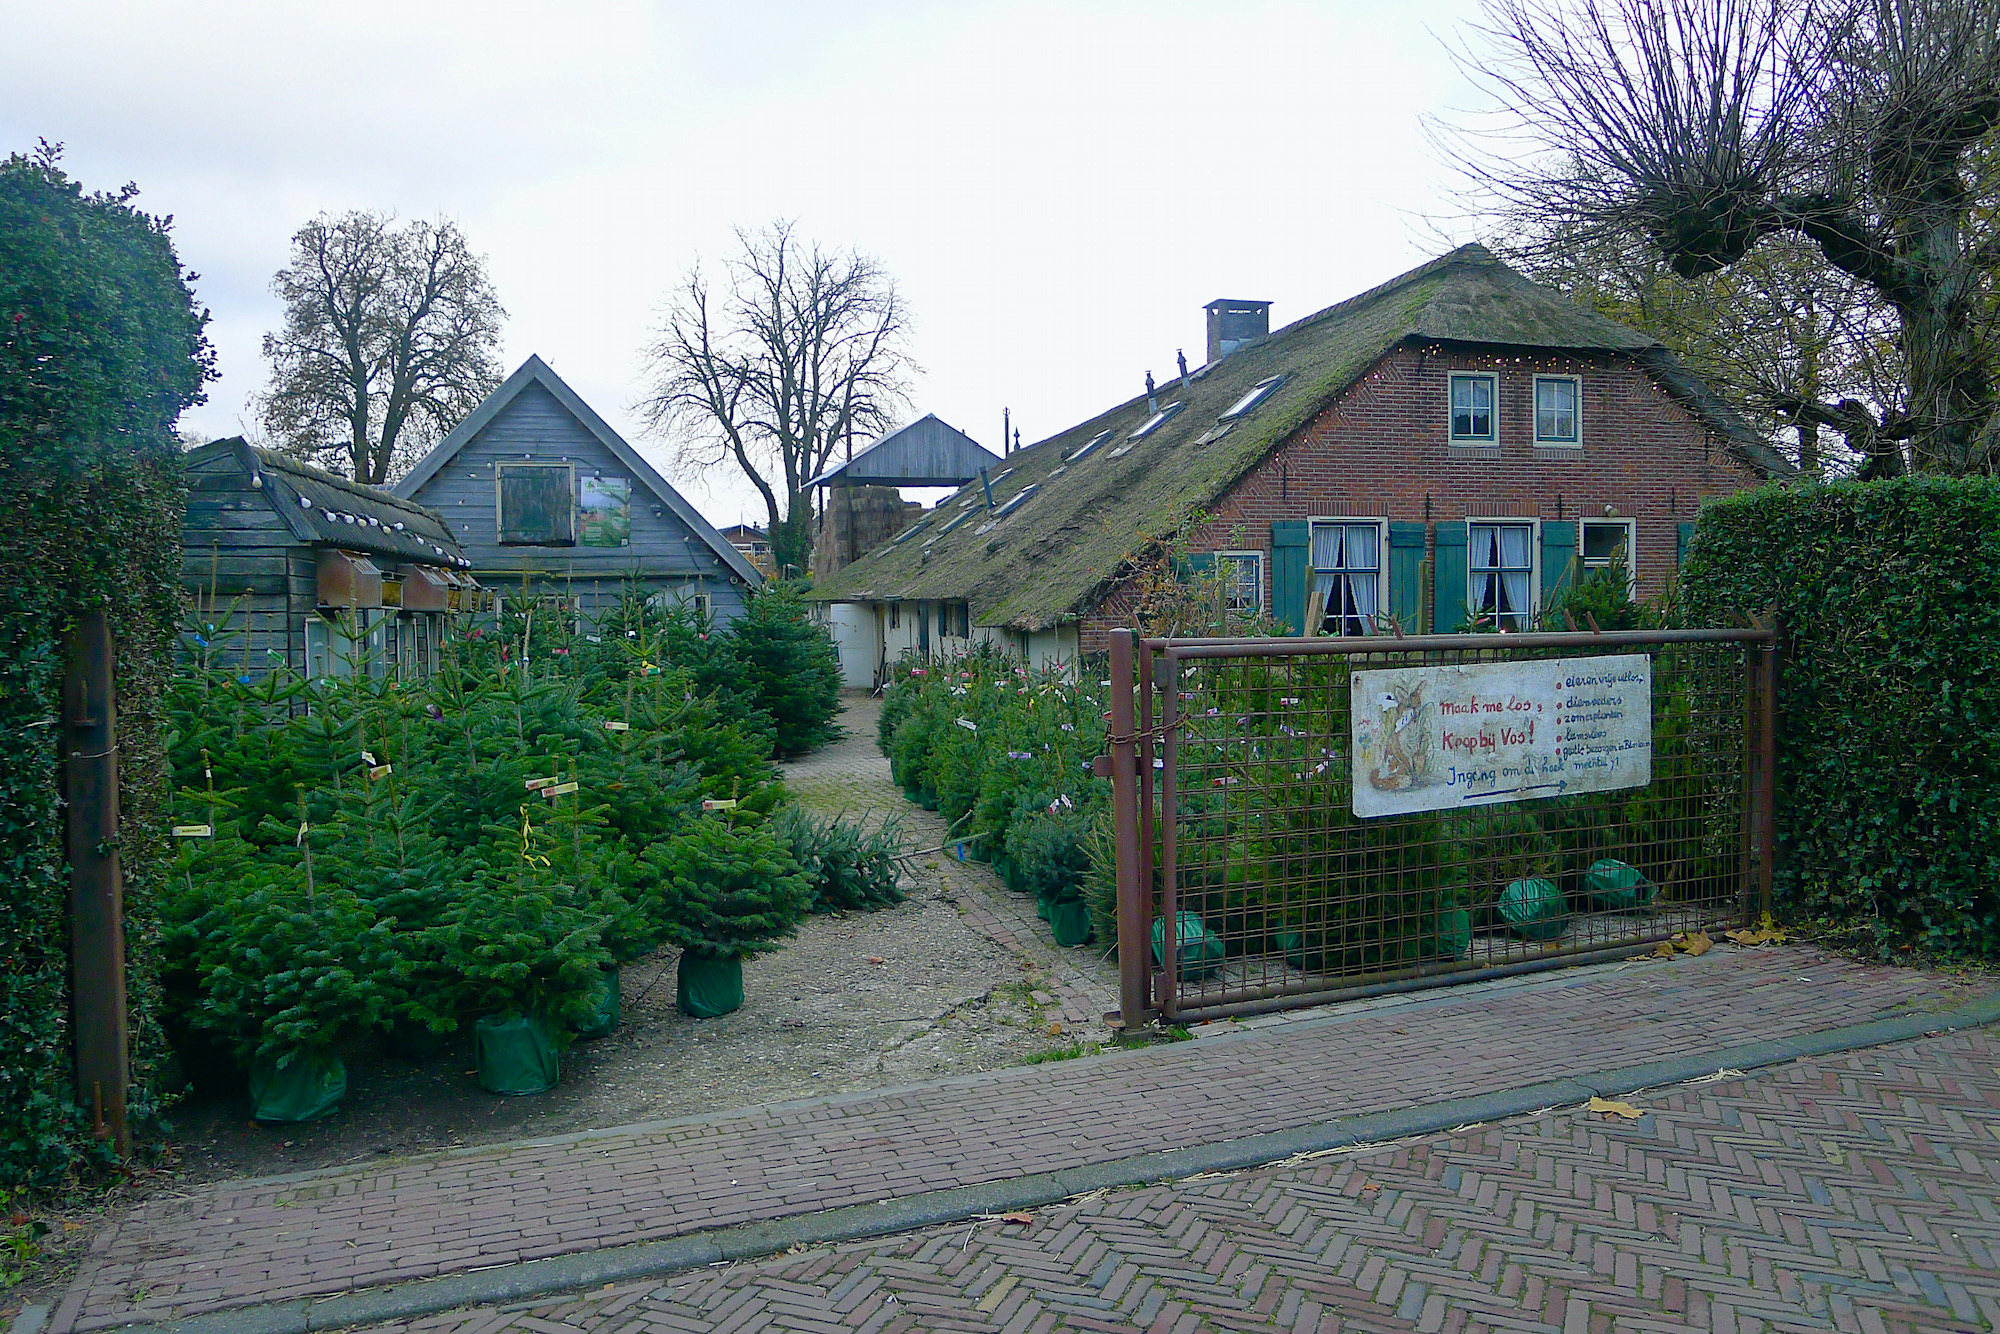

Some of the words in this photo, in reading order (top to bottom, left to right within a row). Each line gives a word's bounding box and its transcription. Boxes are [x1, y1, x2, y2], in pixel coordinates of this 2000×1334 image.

[1482, 702, 1503, 713] me
[1501, 720, 1534, 745] Vos!
[1502, 767, 1521, 777] om
[1524, 757, 1536, 775] d
[1541, 756, 1564, 773] hoek
